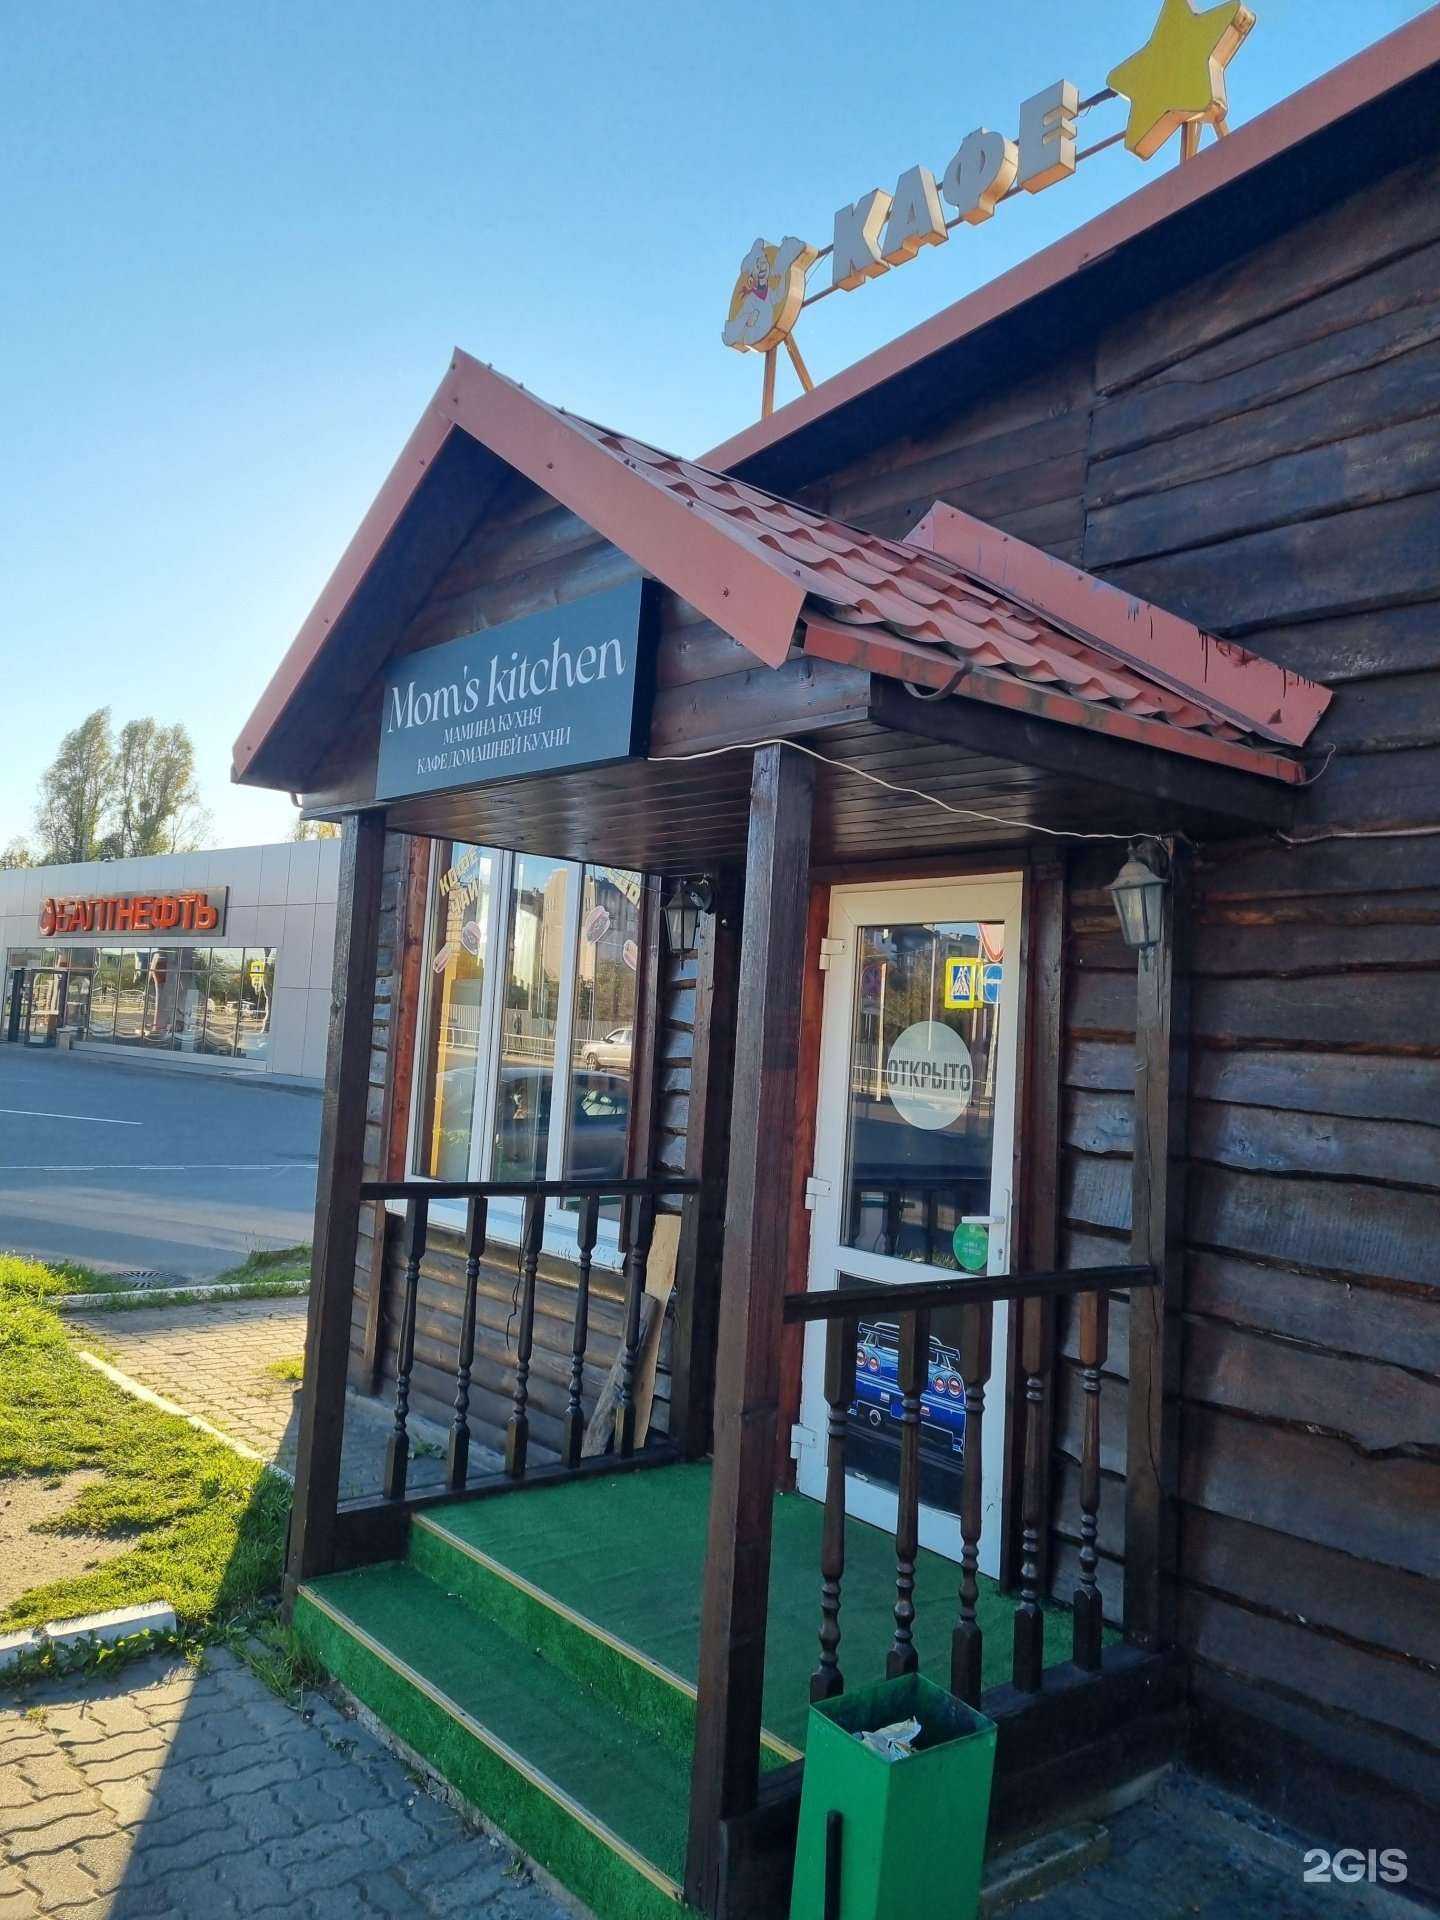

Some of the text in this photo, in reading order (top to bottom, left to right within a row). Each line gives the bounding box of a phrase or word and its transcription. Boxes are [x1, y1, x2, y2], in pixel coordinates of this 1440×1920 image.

[833, 80, 1079, 292] КАФЕ
[387, 637, 627, 733] Mom's kitchen
[443, 706, 542, 745] МАМИНА КУХНЯ
[416, 727, 572, 776] КАФЕ ДОМАШНЕЙ КУХНИ
[55, 891, 218, 933] БАЛТНЕФТЬ
[887, 1059, 971, 1091] ОТКРЫТО
